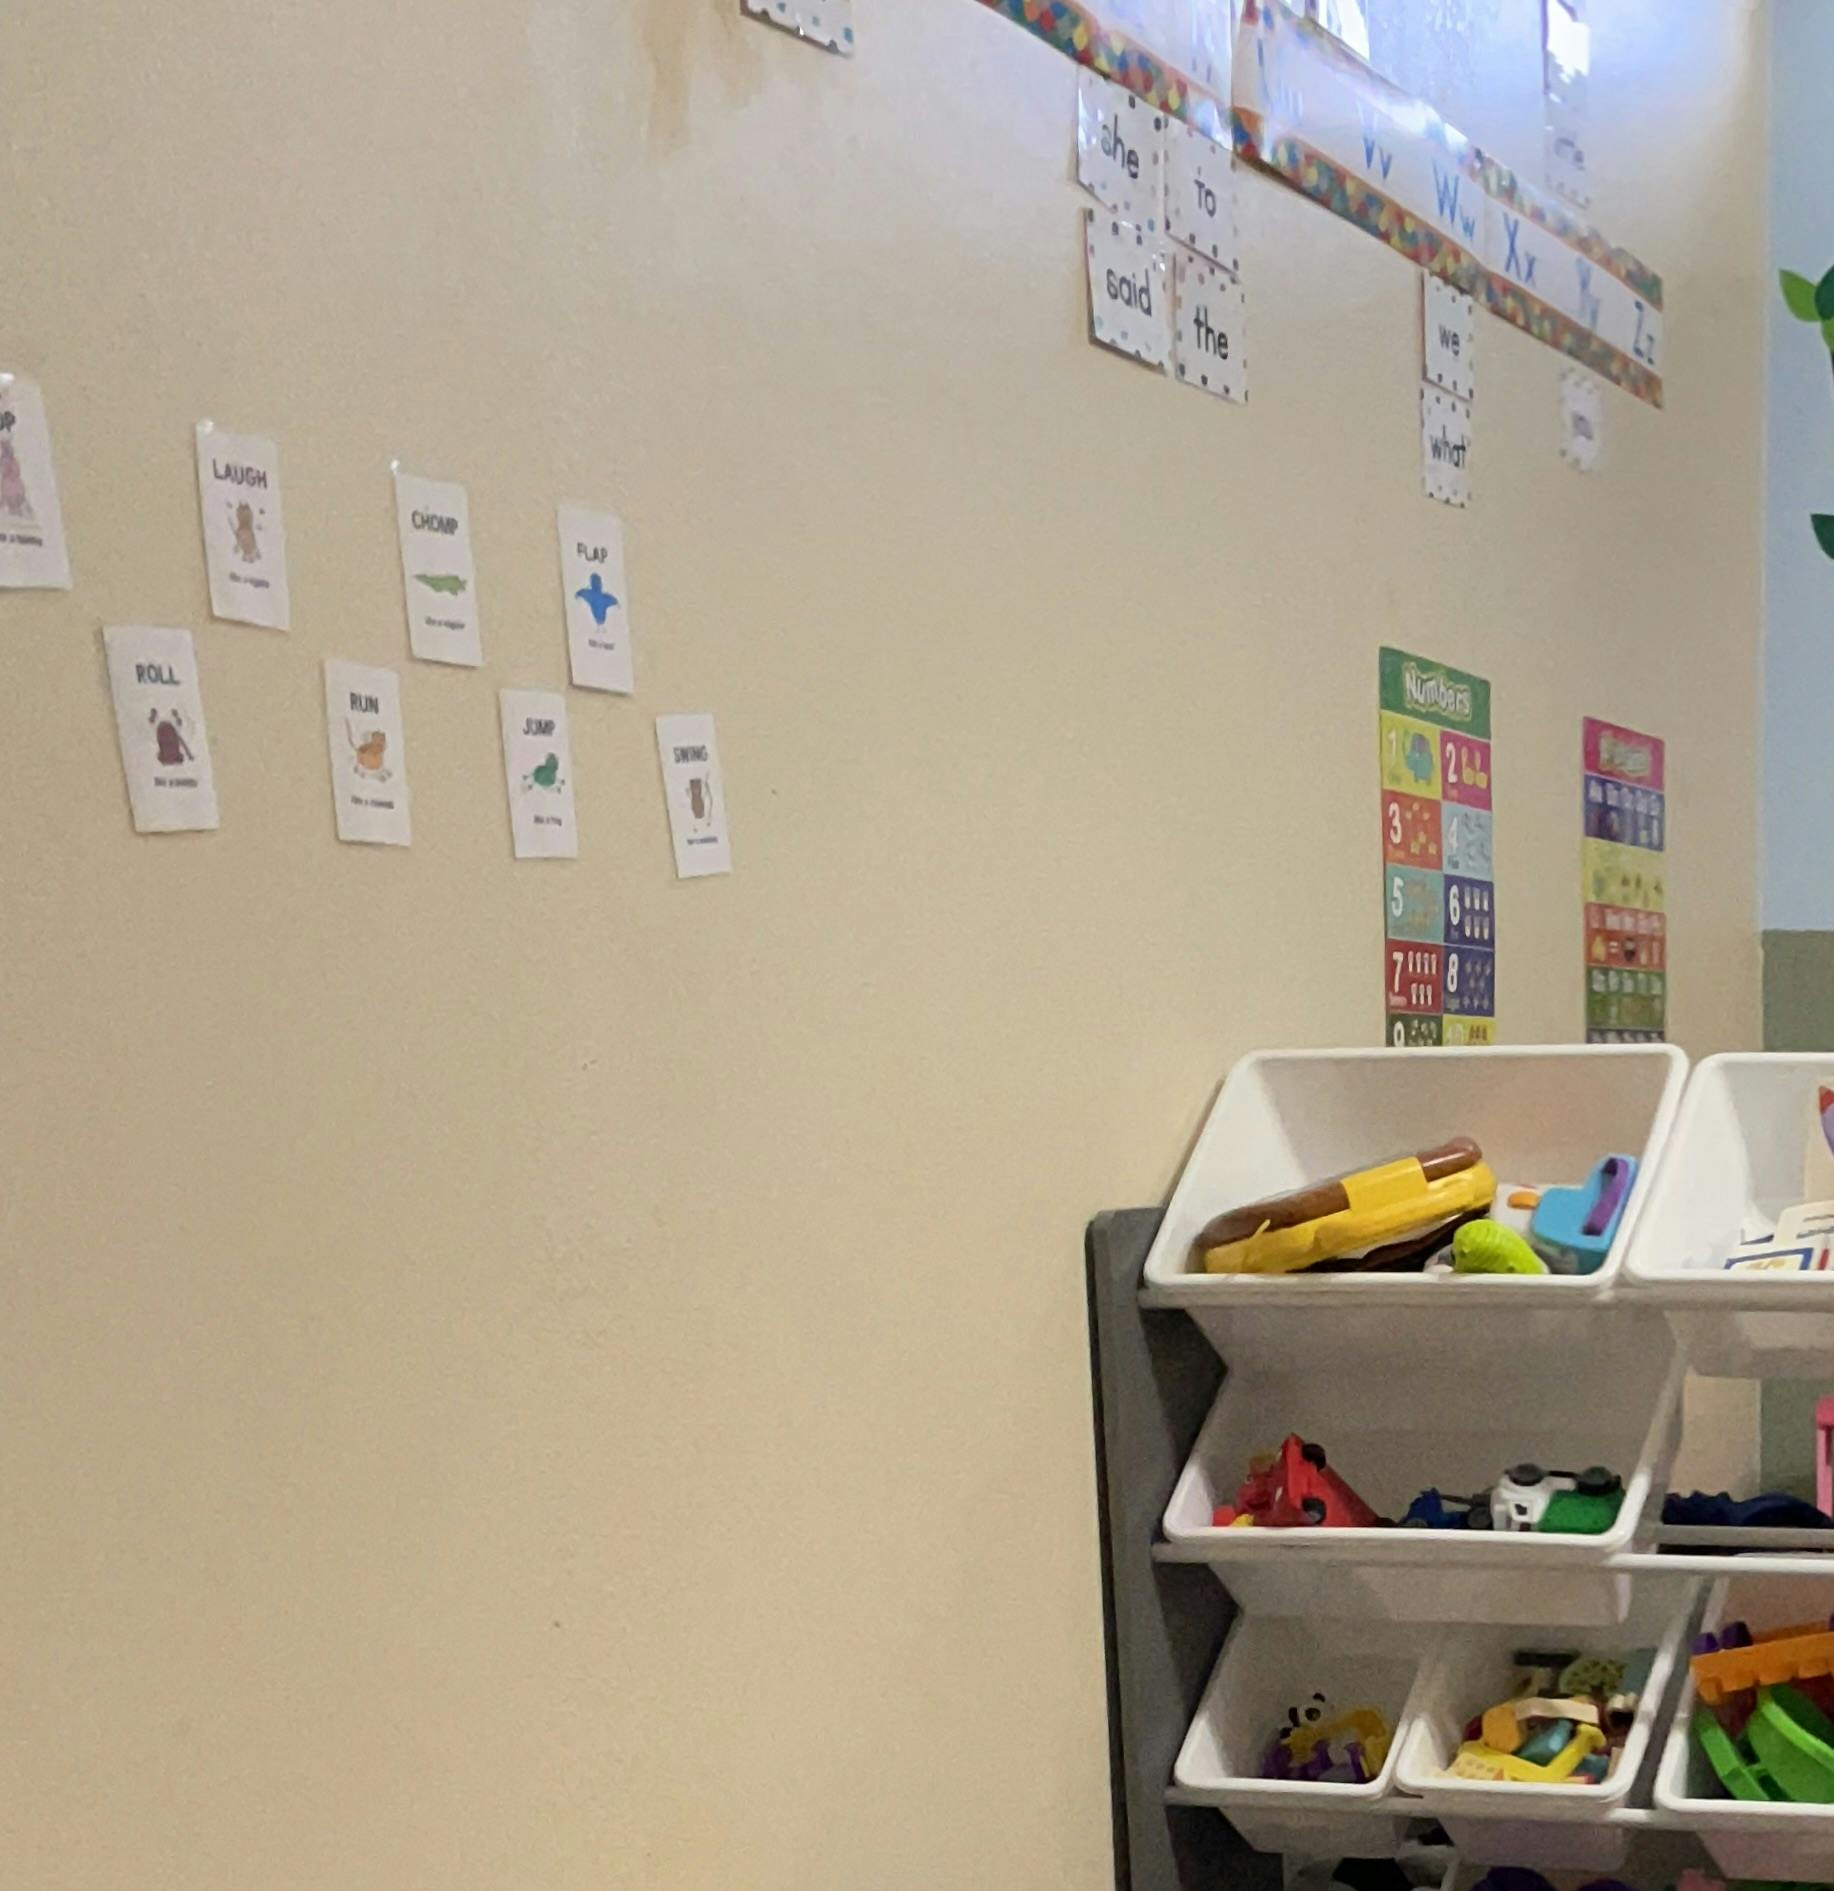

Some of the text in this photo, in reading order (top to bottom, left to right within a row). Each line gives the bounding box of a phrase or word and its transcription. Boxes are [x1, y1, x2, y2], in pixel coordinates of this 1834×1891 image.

[1101, 114, 1140, 179] she
[1503, 212, 1537, 287] Xx
[1107, 267, 1152, 317] said
[1194, 304, 1228, 360] the
[1439, 325, 1460, 356] we
[1430, 424, 1466, 468] what
[212, 458, 268, 489] LAUGH
[411, 510, 459, 535] CHOMP
[577, 542, 608, 563] FLAP
[136, 664, 181, 685] ROLL
[1405, 670, 1470, 714] Numbers
[350, 692, 379, 714] RUN
[523, 718, 556, 737] JUMP
[673, 745, 709, 764] SWING
[1446, 742, 1458, 784] 2
[1389, 802, 1402, 844] 3
[1392, 876, 1404, 917] 5
[1449, 884, 1460, 926] 6
[1392, 951, 1404, 993] 7
[1447, 952, 1459, 993] 8
